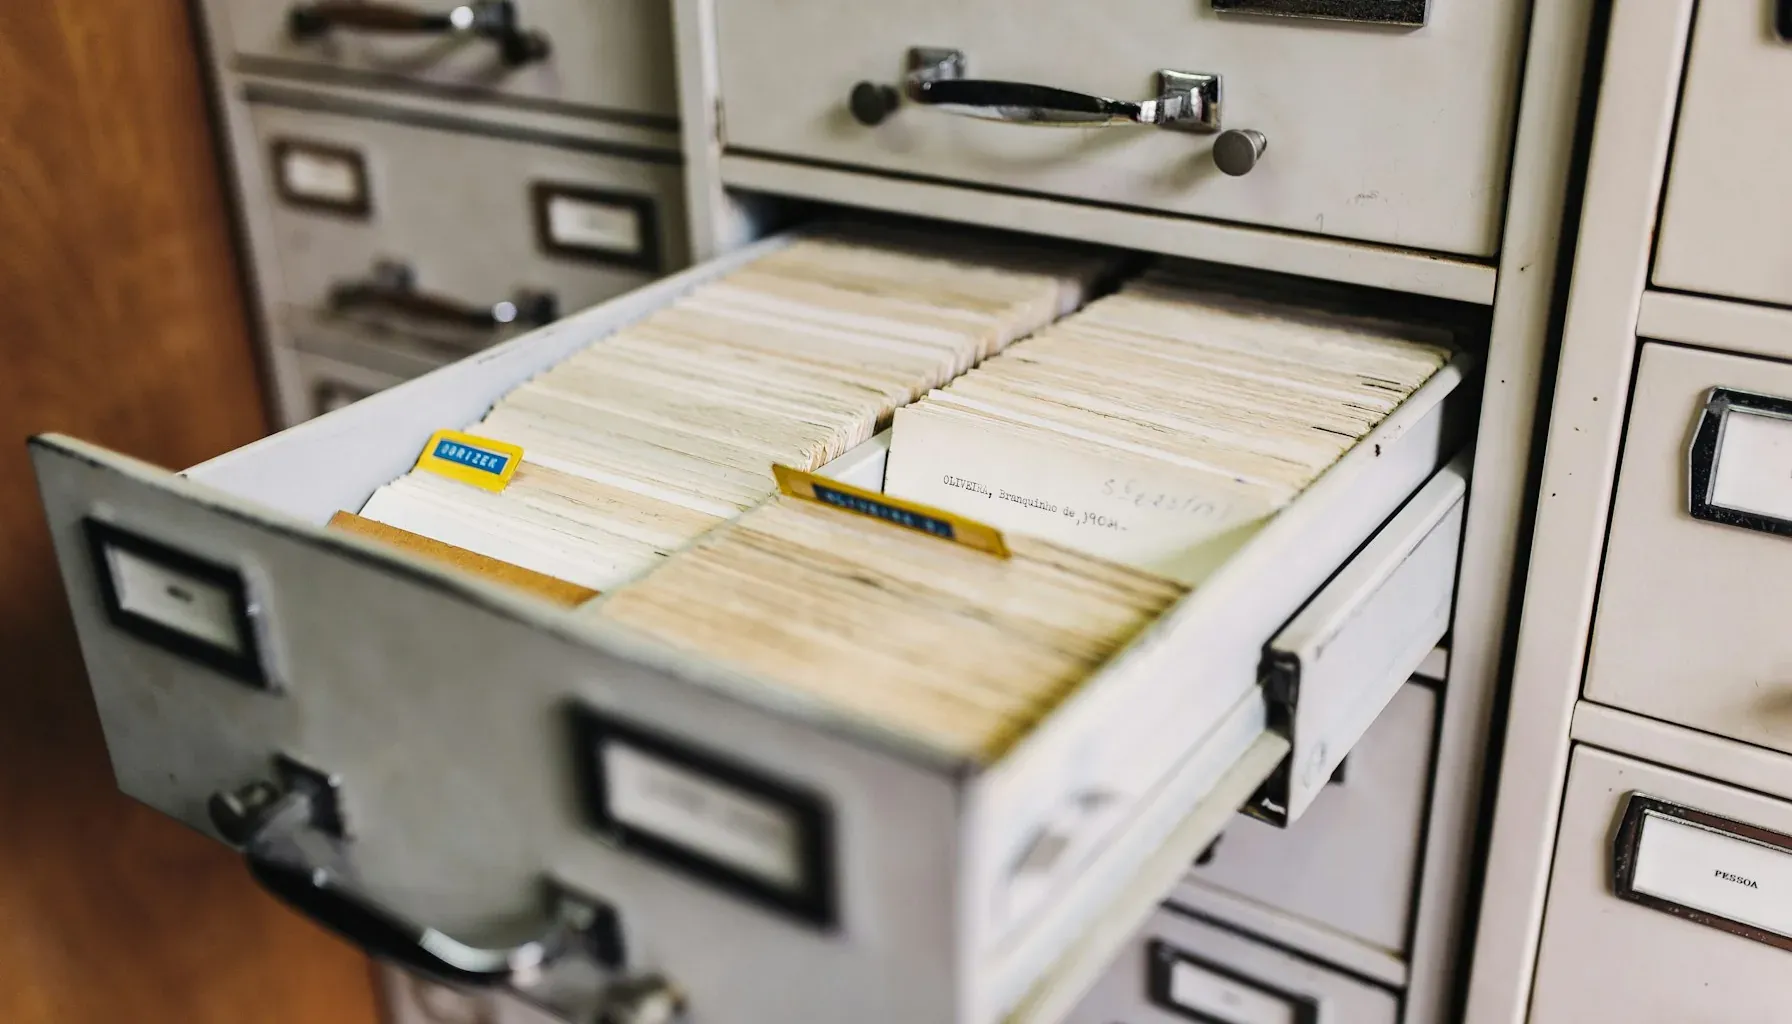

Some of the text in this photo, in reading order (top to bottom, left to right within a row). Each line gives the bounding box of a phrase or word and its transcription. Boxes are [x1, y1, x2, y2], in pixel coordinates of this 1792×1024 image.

[942, 475, 993, 499] OLIVEIRA,
[998, 488, 1058, 513] Branquinho
[1713, 869, 1759, 889] PESSOA
